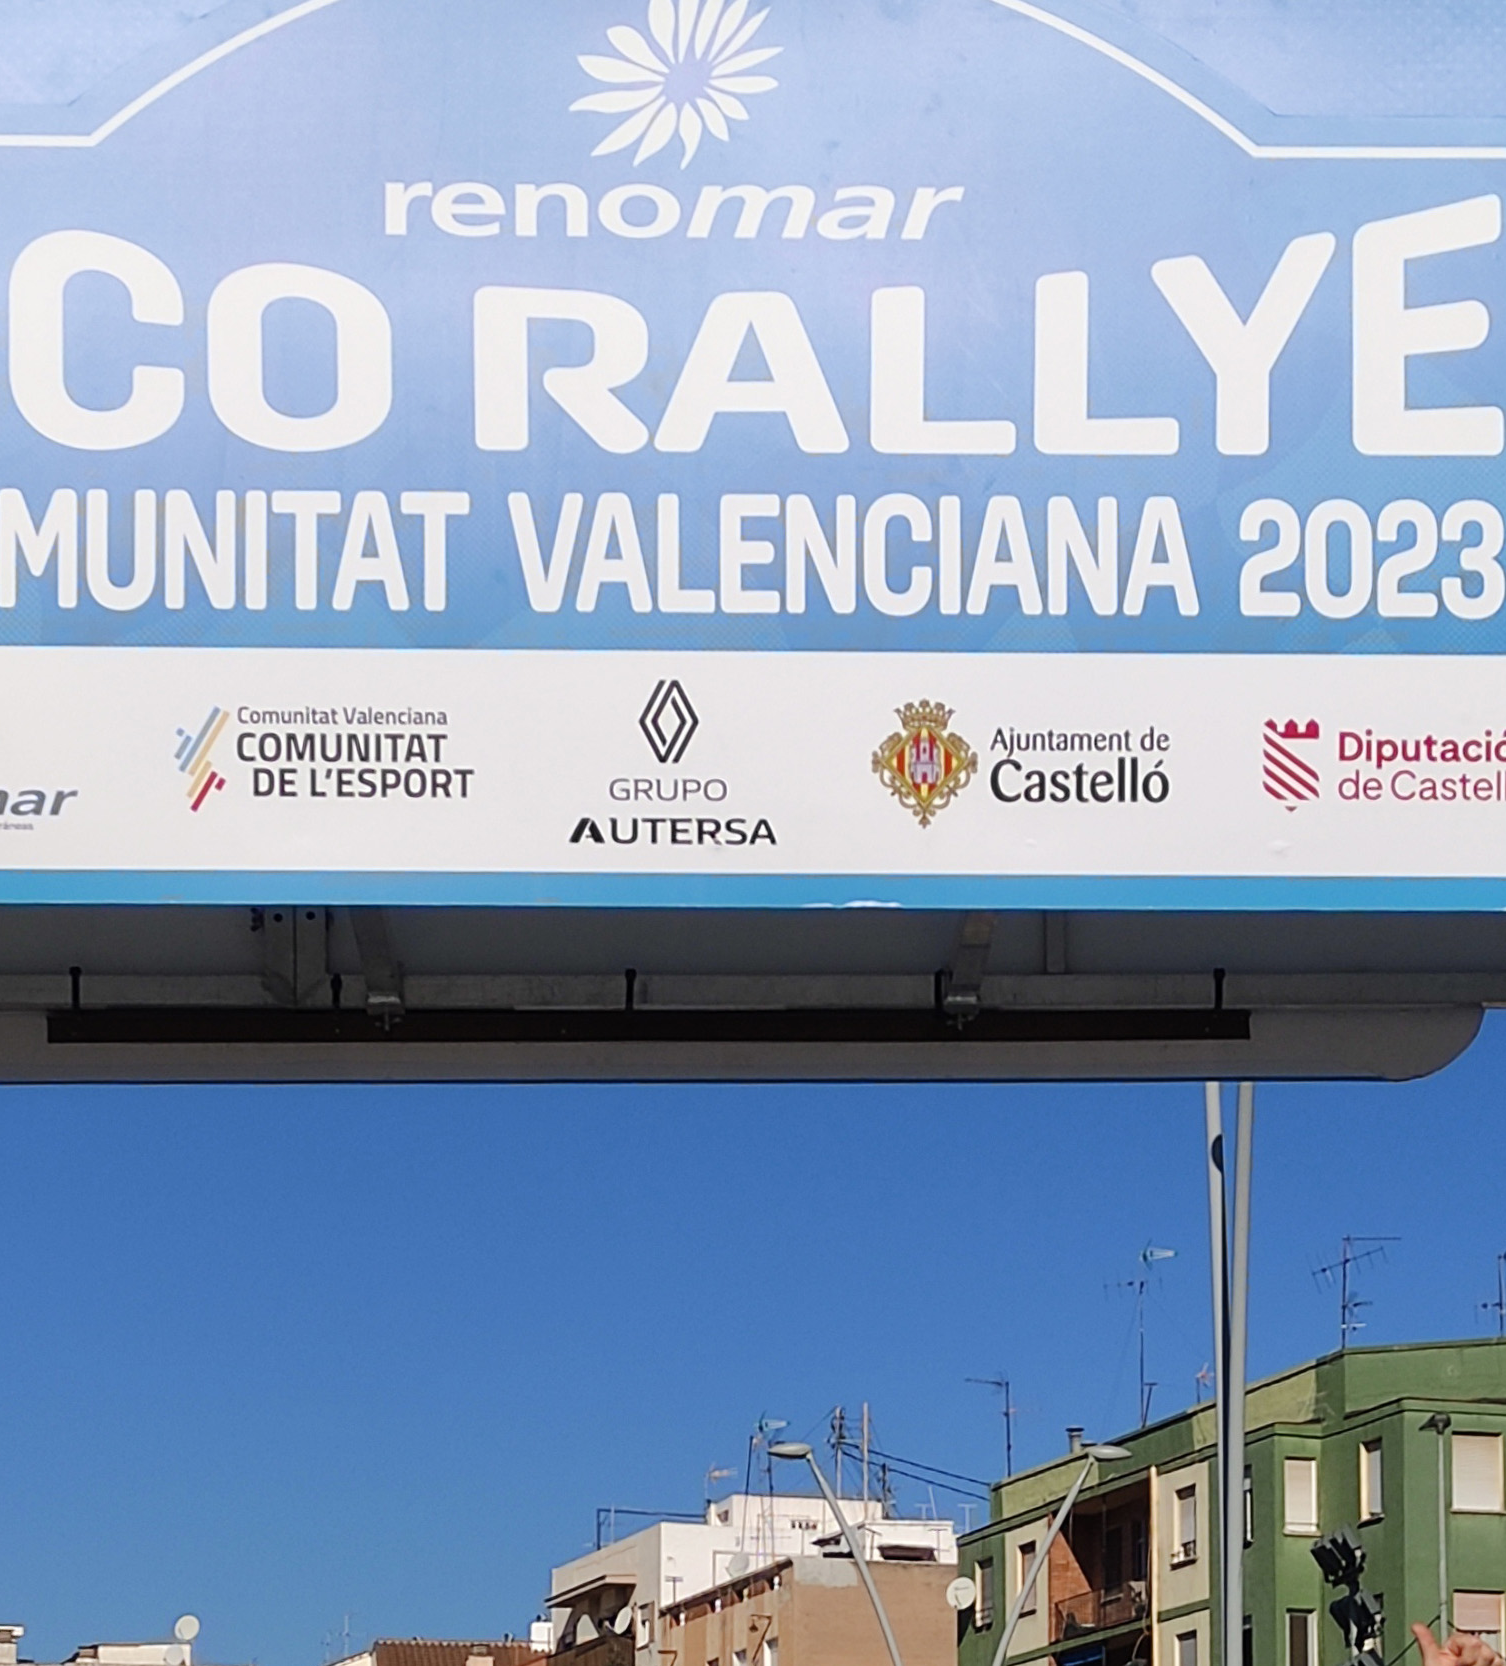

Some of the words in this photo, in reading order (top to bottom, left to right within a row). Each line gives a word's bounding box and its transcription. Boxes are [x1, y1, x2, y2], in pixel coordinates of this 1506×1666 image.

[383, 180, 964, 241] renomar
[474, 193, 1505, 456] RALLYE
[507, 491, 1200, 616] VALENCIANA
[1239, 498, 1506, 620] 2023
[237, 706, 338, 725] Comunitat
[342, 707, 447, 726] Valenciana
[236, 732, 447, 763] COMUNITAT
[990, 725, 1132, 758] Ajuntament
[1141, 725, 1170, 753] de
[253, 768, 297, 797] DE
[308, 768, 474, 798] L'ESPORT
[608, 778, 728, 802] GRUPO
[989, 758, 1170, 804] Castelló
[1338, 771, 1381, 802] de
[569, 817, 777, 846] AUTERSA
